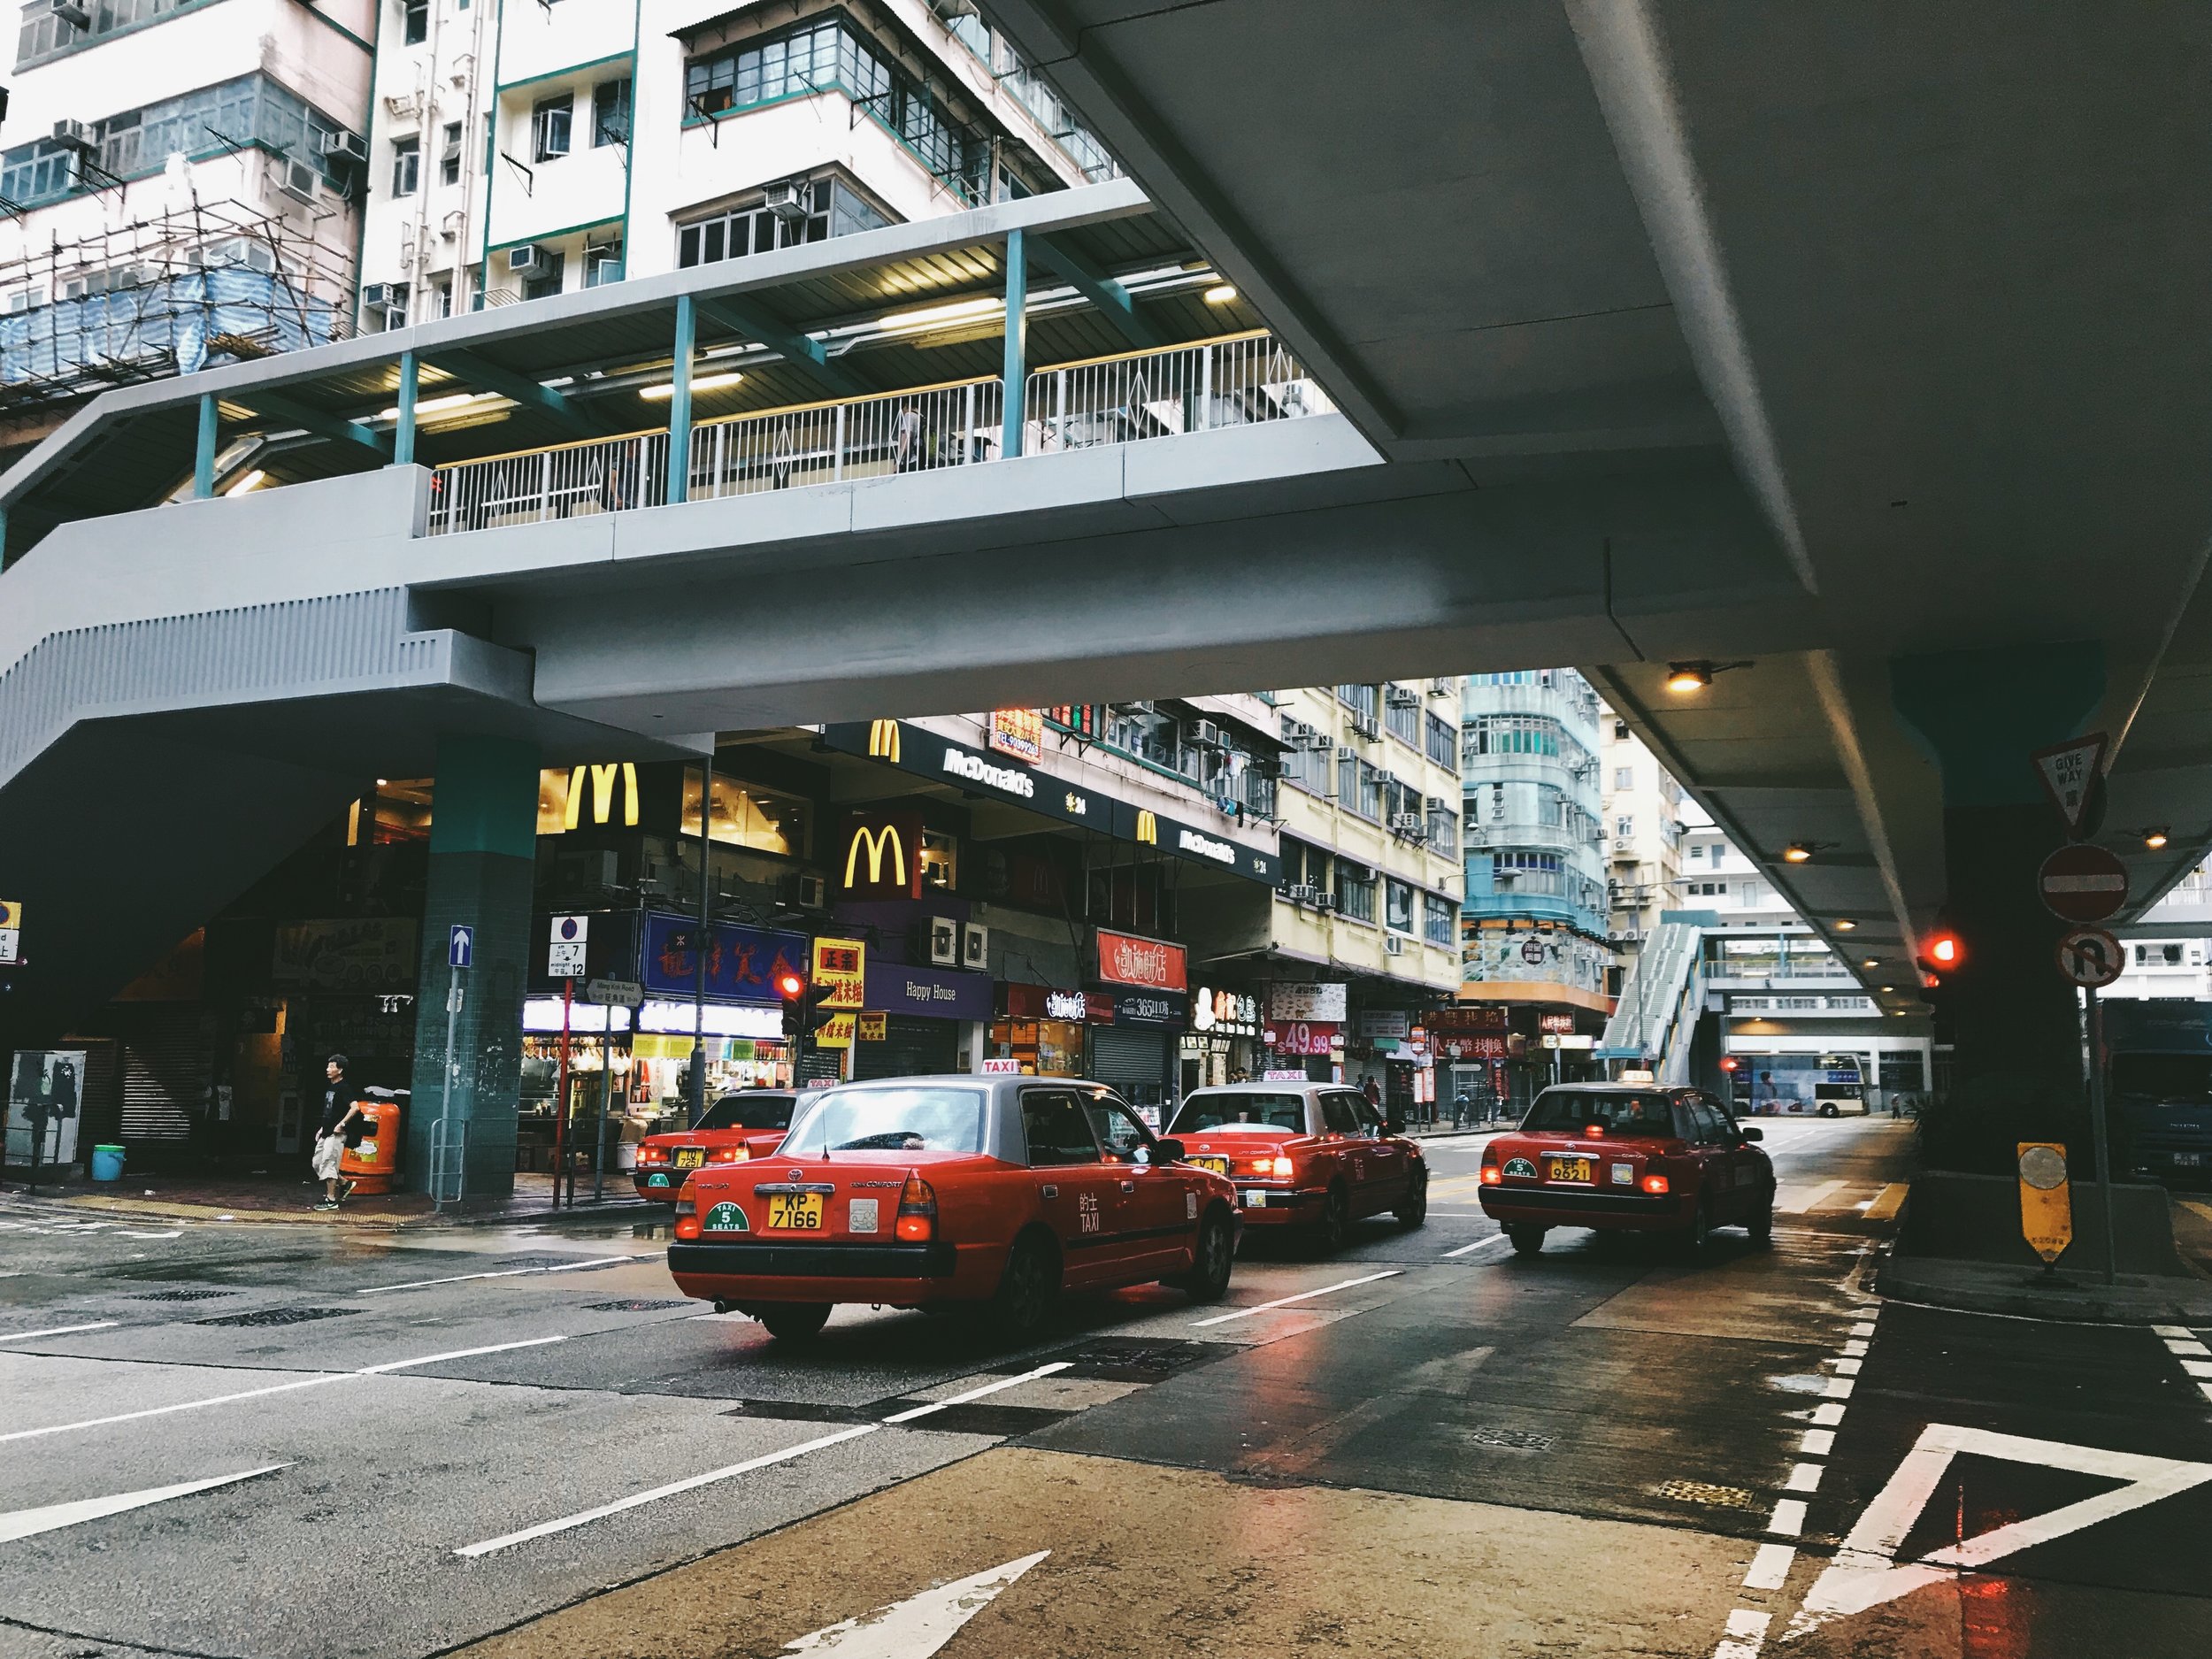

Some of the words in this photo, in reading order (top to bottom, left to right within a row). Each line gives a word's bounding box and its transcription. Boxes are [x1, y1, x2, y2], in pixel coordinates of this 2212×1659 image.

[2055, 753, 2083, 771] GIVE
[943, 748, 1034, 798] McDonald's
[1074, 797, 1087, 815] 24
[2057, 769, 2083, 786] WAY
[1179, 830, 1235, 864] McDonald's
[572, 945, 579, 956] 7
[825, 950, 853, 972] 正宗
[572, 964, 583, 975] 12
[906, 980, 931, 1002] Happy
[933, 984, 956, 1001] House
[984, 1061, 1015, 1072] TAXI
[1267, 1071, 1302, 1079] TAXI
[810, 1079, 835, 1087] TAXI
[680, 1157, 700, 1167] 7251
[1517, 1164, 1525, 1172] 5
[1562, 1158, 1578, 1170] EF
[1553, 1168, 1587, 1180] 9621
[716, 1202, 737, 1213] TAXI
[785, 1194, 809, 1211] KP
[1079, 1193, 1098, 1212] 的士
[720, 1211, 731, 1224] 5
[773, 1210, 818, 1228] 7166
[1080, 1212, 1100, 1233] TAXI
